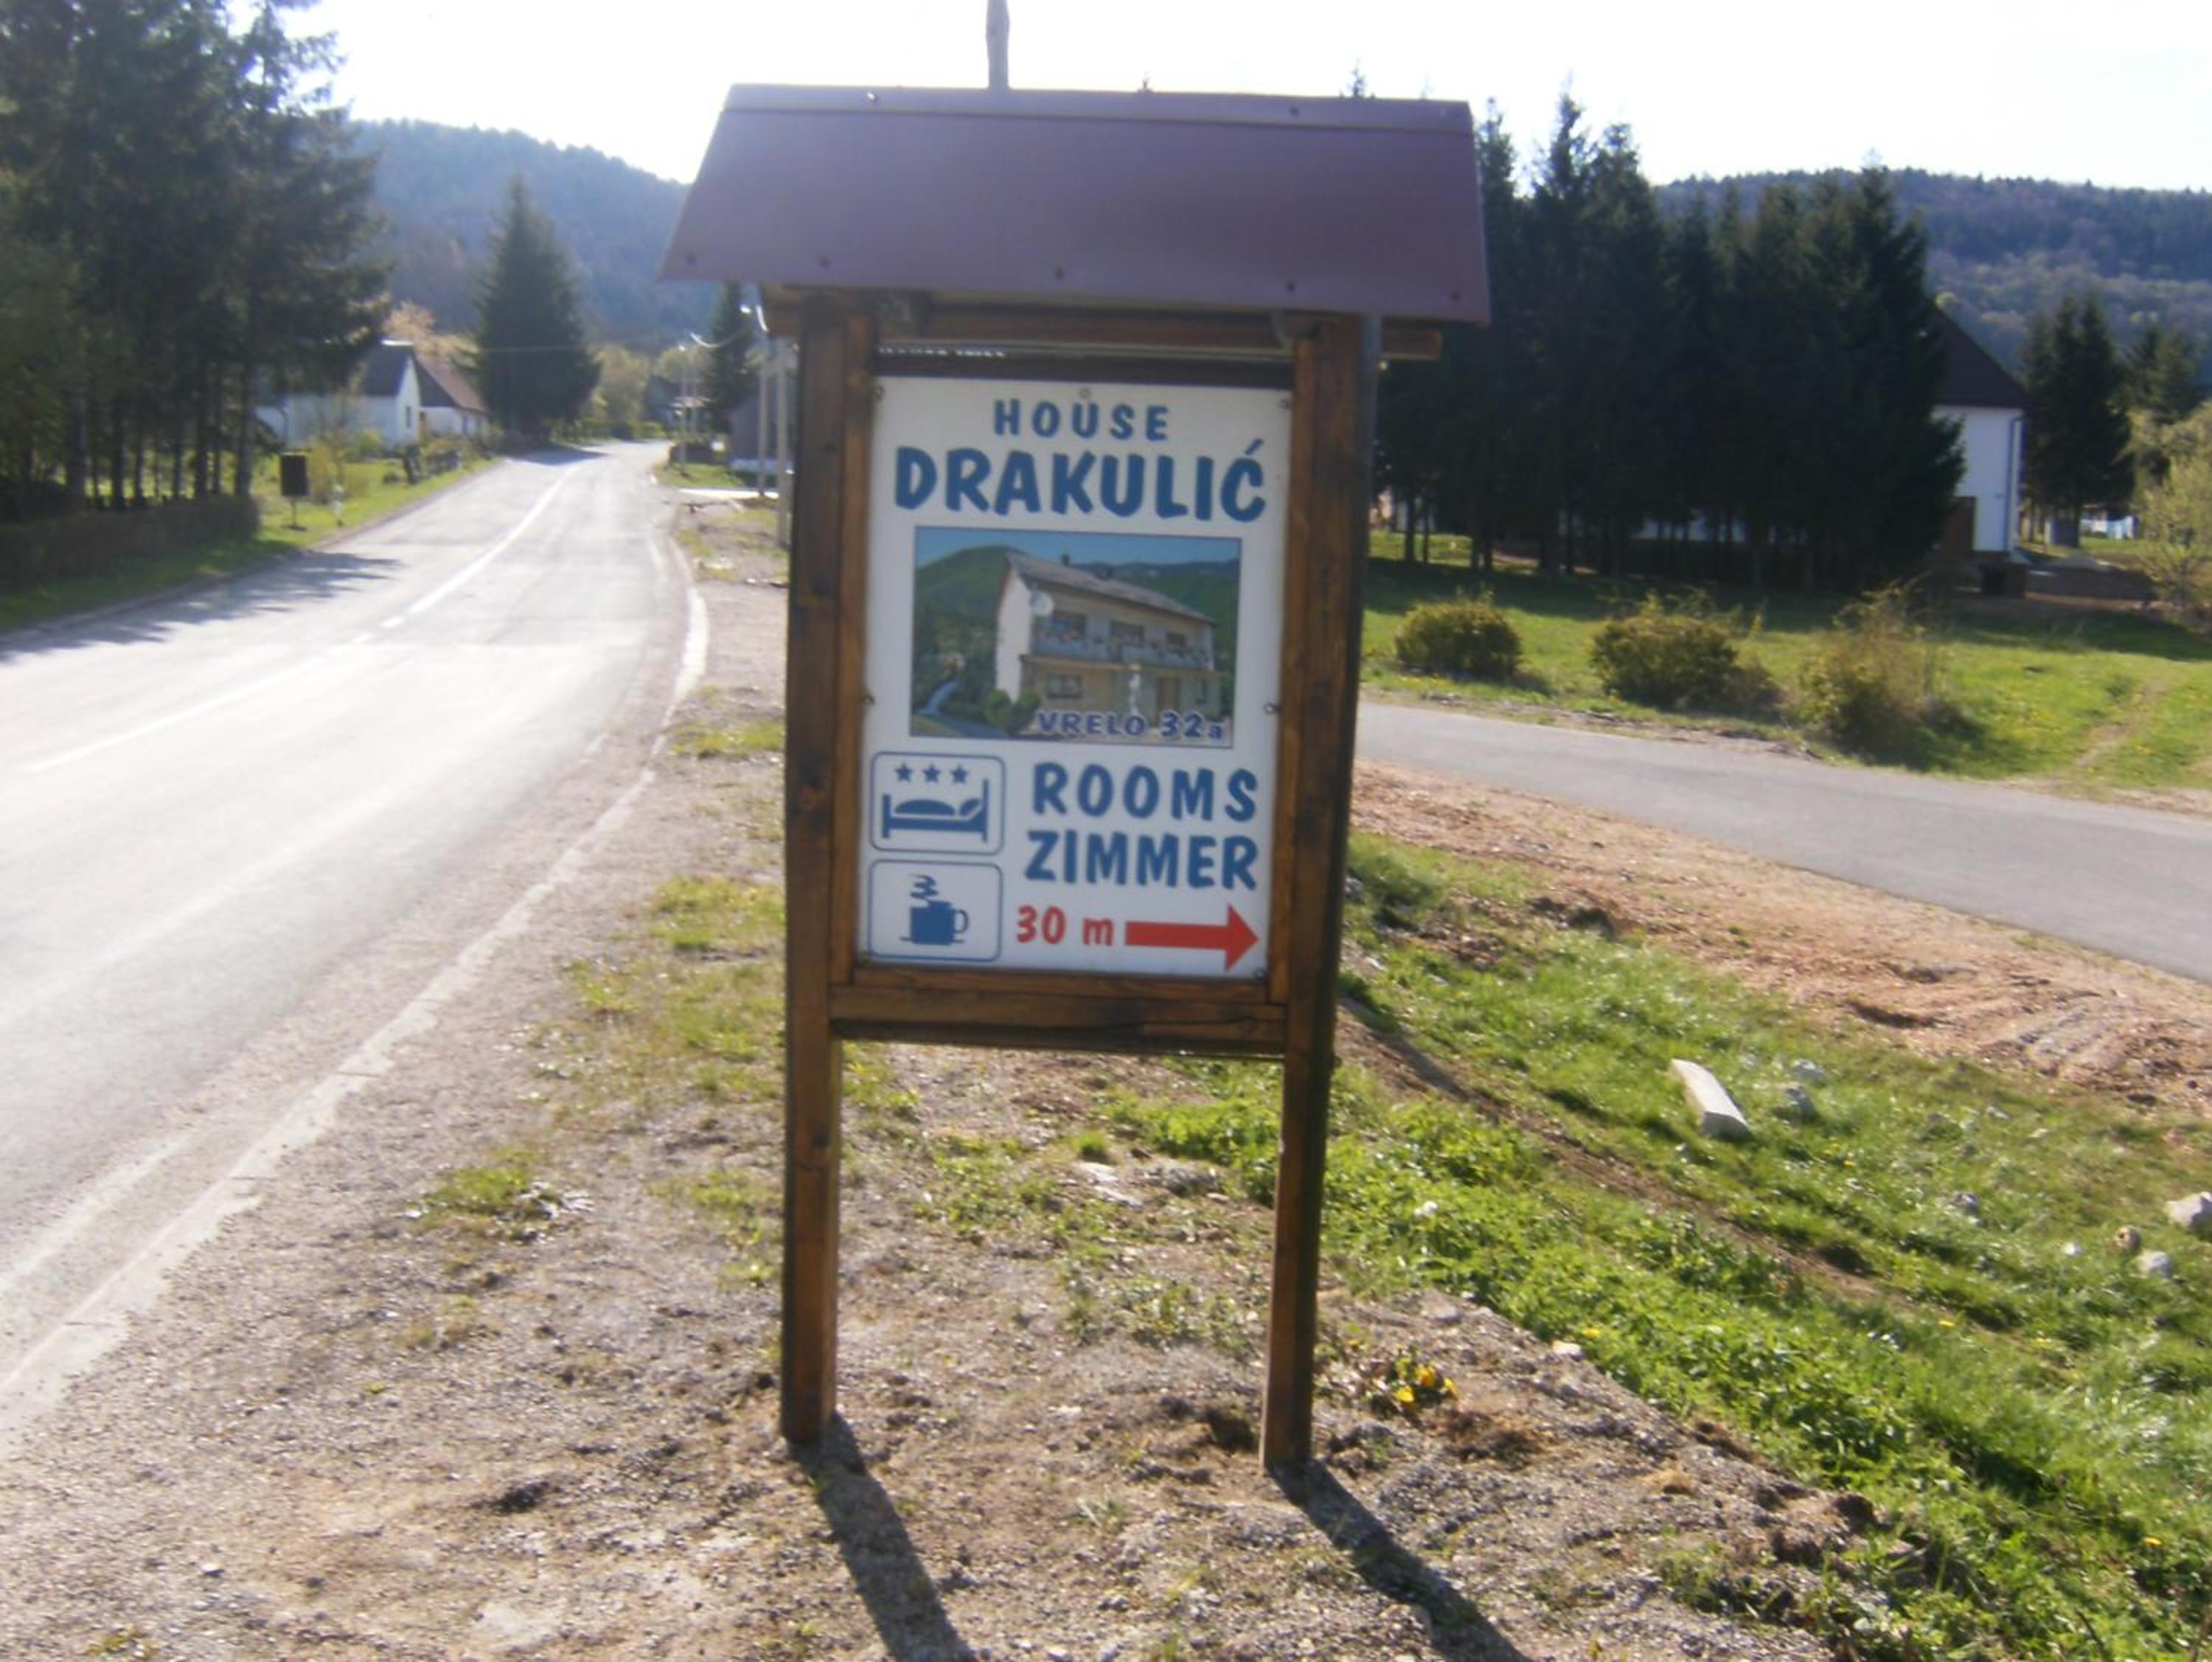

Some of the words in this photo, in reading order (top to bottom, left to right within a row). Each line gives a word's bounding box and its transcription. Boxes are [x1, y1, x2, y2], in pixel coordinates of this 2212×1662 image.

[993, 399, 1169, 442] HOUSE
[894, 439, 1266, 523] DRAKULIĆ
[1037, 712, 1147, 736] VRELO
[1160, 711, 1222, 740] 32a
[1032, 762, 1259, 822] ROOMS
[1024, 830, 1259, 891] ZIMMER
[1015, 905, 1067, 945] 30
[1082, 917, 1114, 947] m
